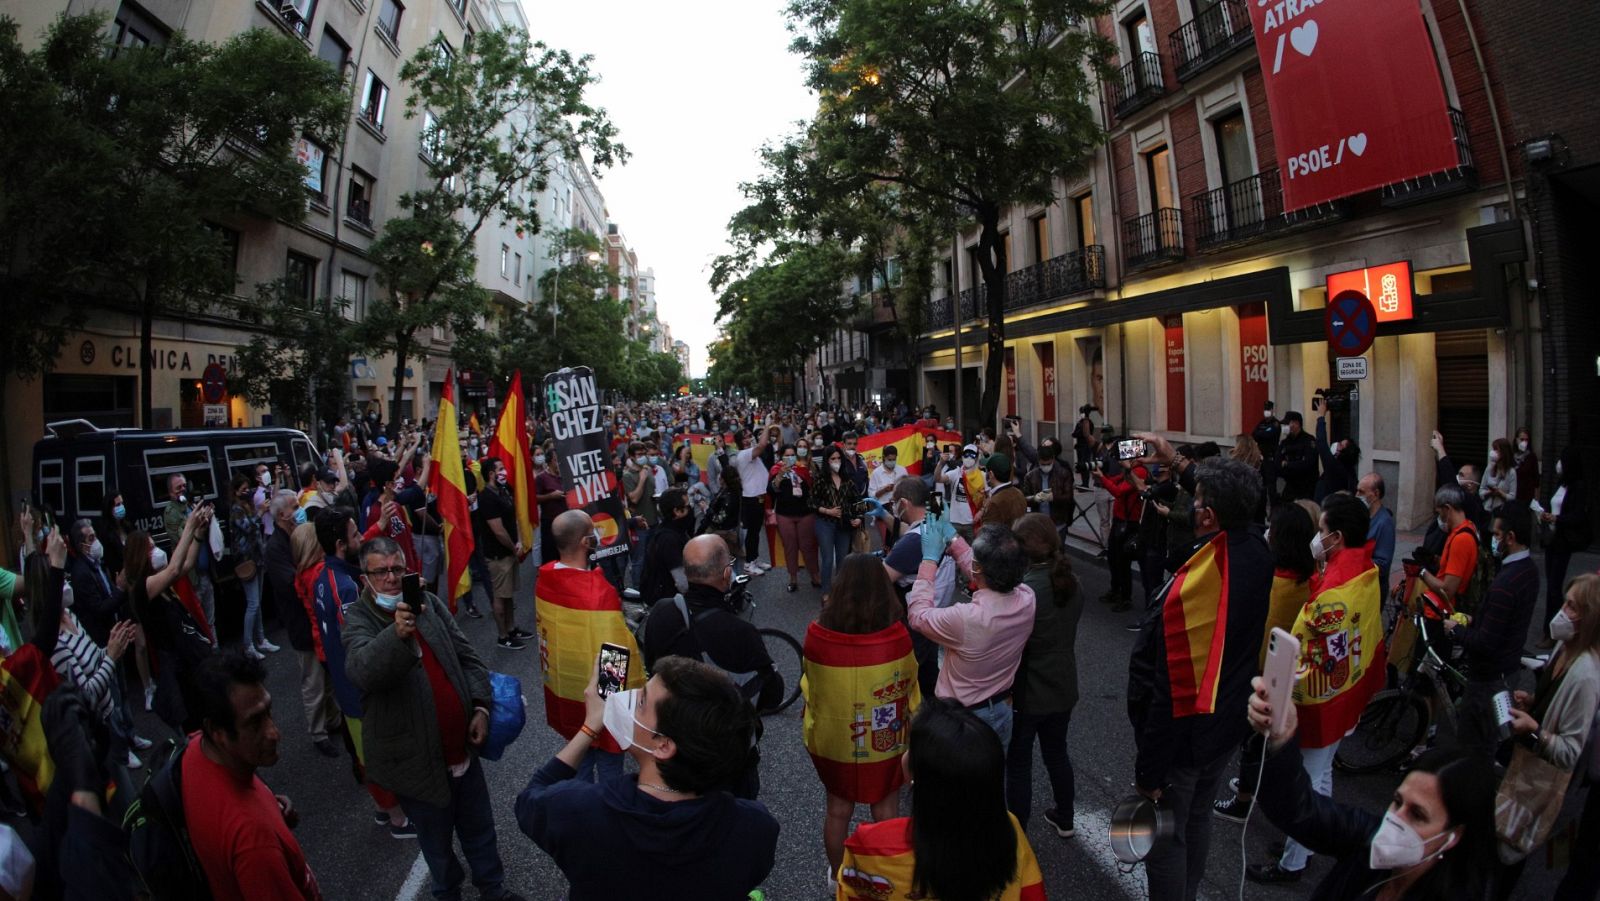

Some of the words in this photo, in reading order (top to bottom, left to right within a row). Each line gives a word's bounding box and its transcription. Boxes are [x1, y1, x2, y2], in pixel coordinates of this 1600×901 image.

[1263, 0, 1322, 34] ATRA
[1286, 144, 1332, 179] PSOE
[112, 345, 191, 371] CLNICA
[547, 374, 599, 413] #SÁN
[551, 404, 604, 441] CHEZ
[566, 448, 606, 477] VETE
